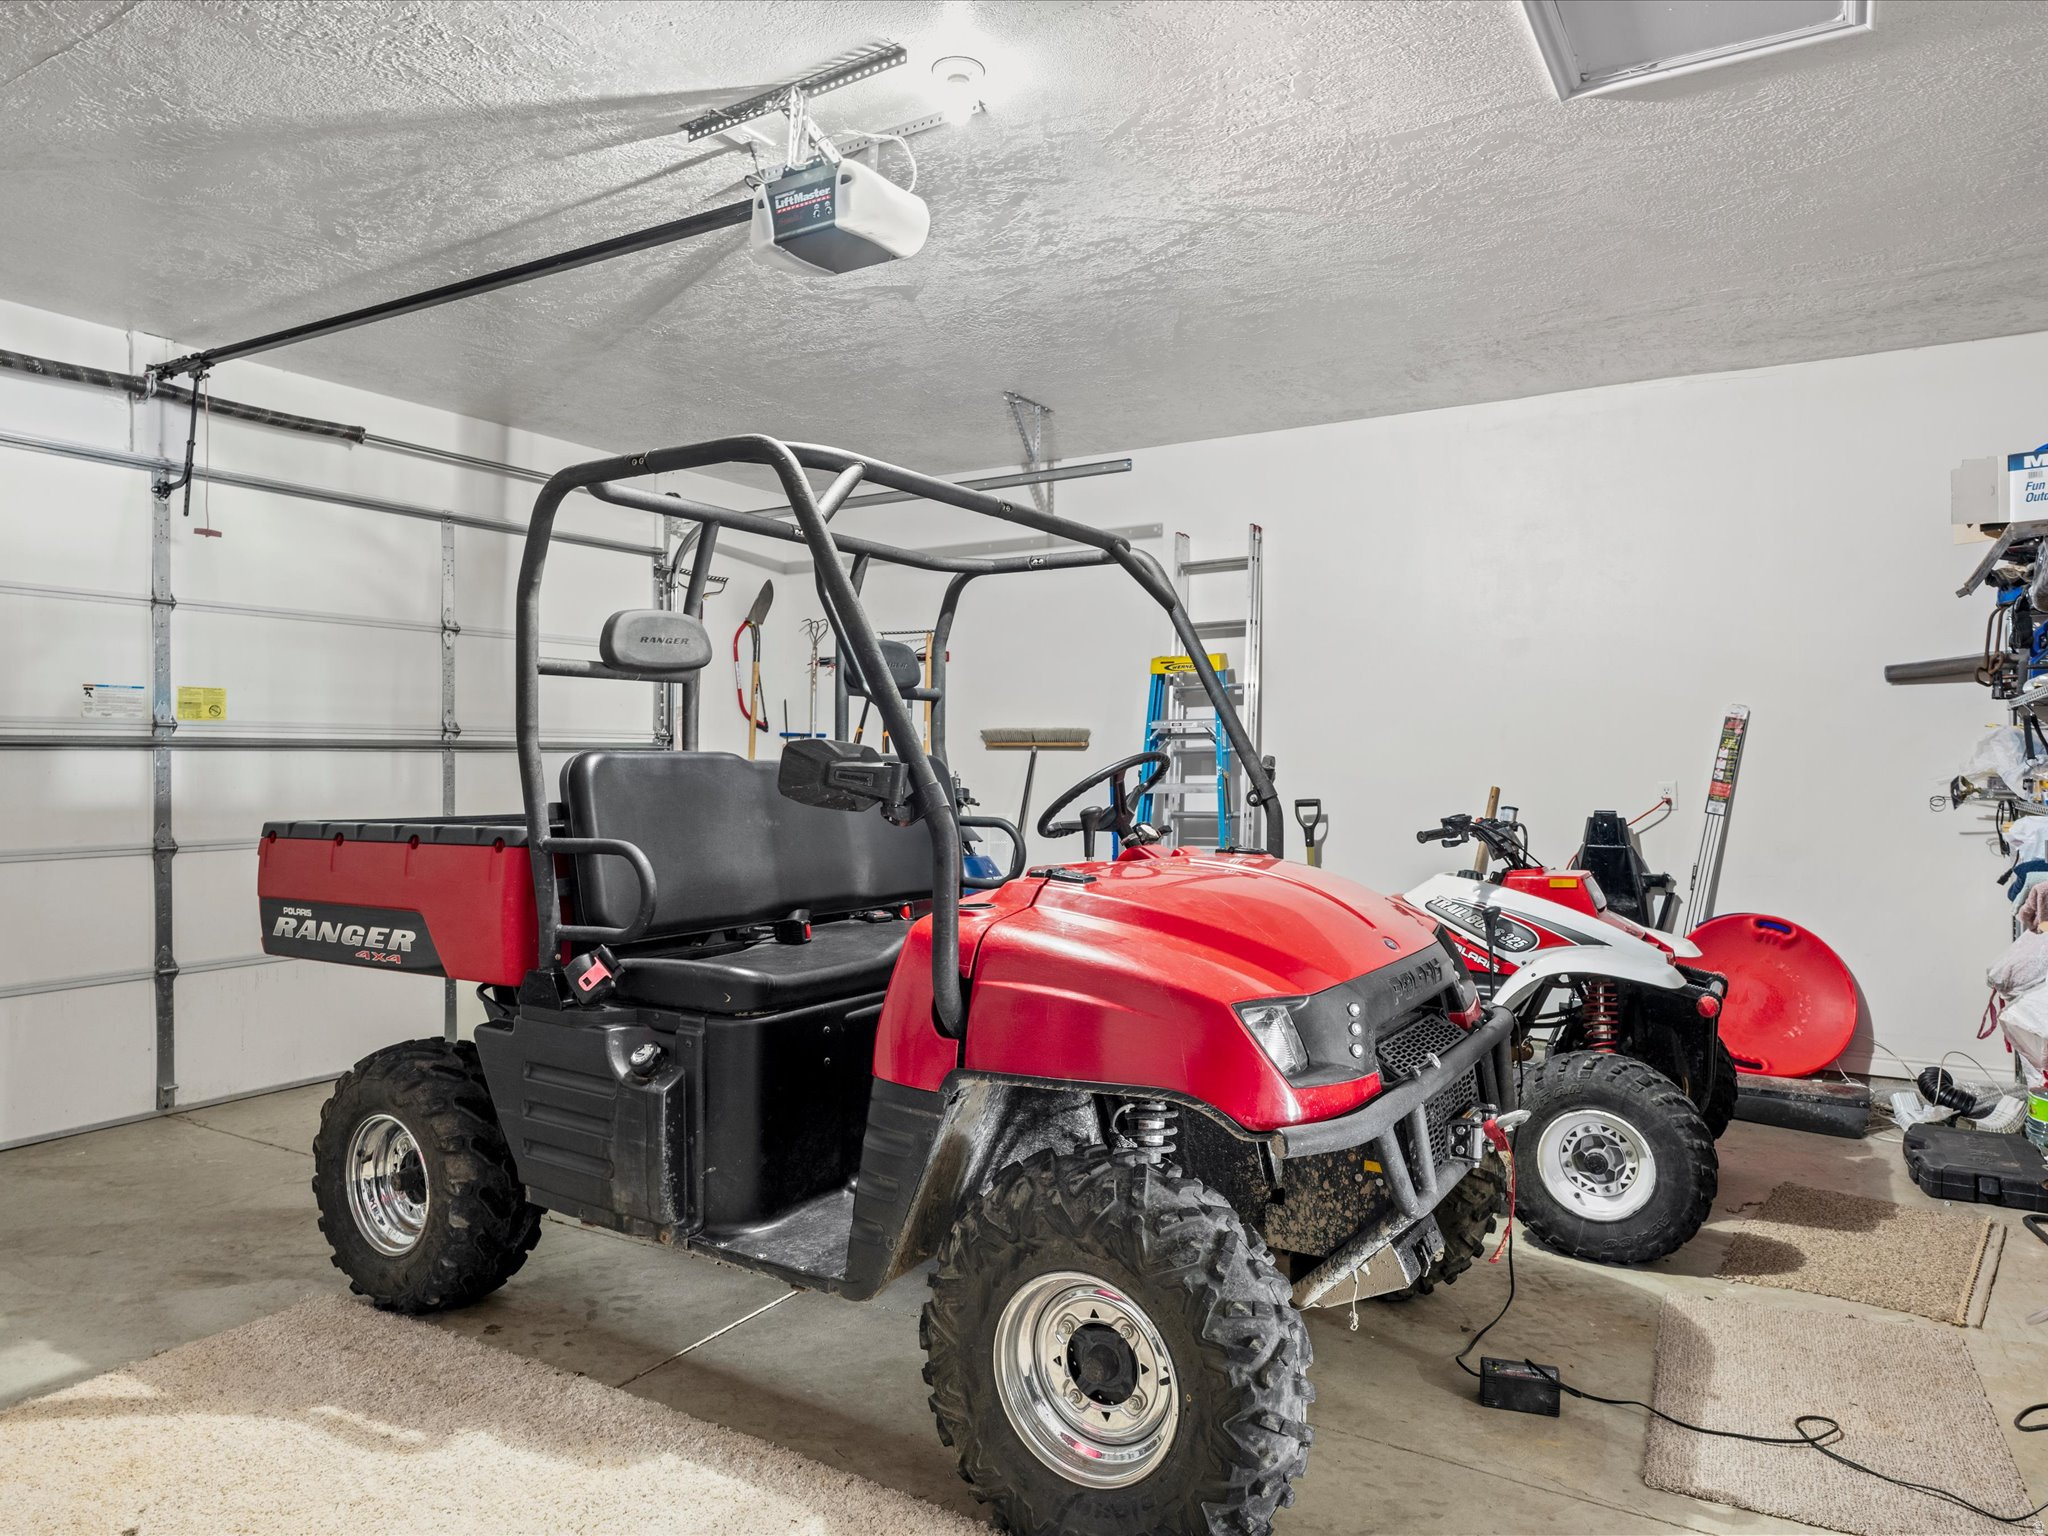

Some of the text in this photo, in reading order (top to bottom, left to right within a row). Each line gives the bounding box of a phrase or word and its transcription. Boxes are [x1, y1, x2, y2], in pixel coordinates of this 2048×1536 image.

[775, 187, 831, 209] LiftMaster
[2025, 481, 2046, 491] Fun
[640, 636, 689, 645] RANGER
[283, 907, 312, 917] POLARIS
[1431, 897, 1469, 918] TRAIL
[1464, 914, 1506, 937] BOS
[1500, 933, 1529, 948] 325
[272, 916, 416, 952] RANGER
[1455, 942, 1500, 973] LARIS
